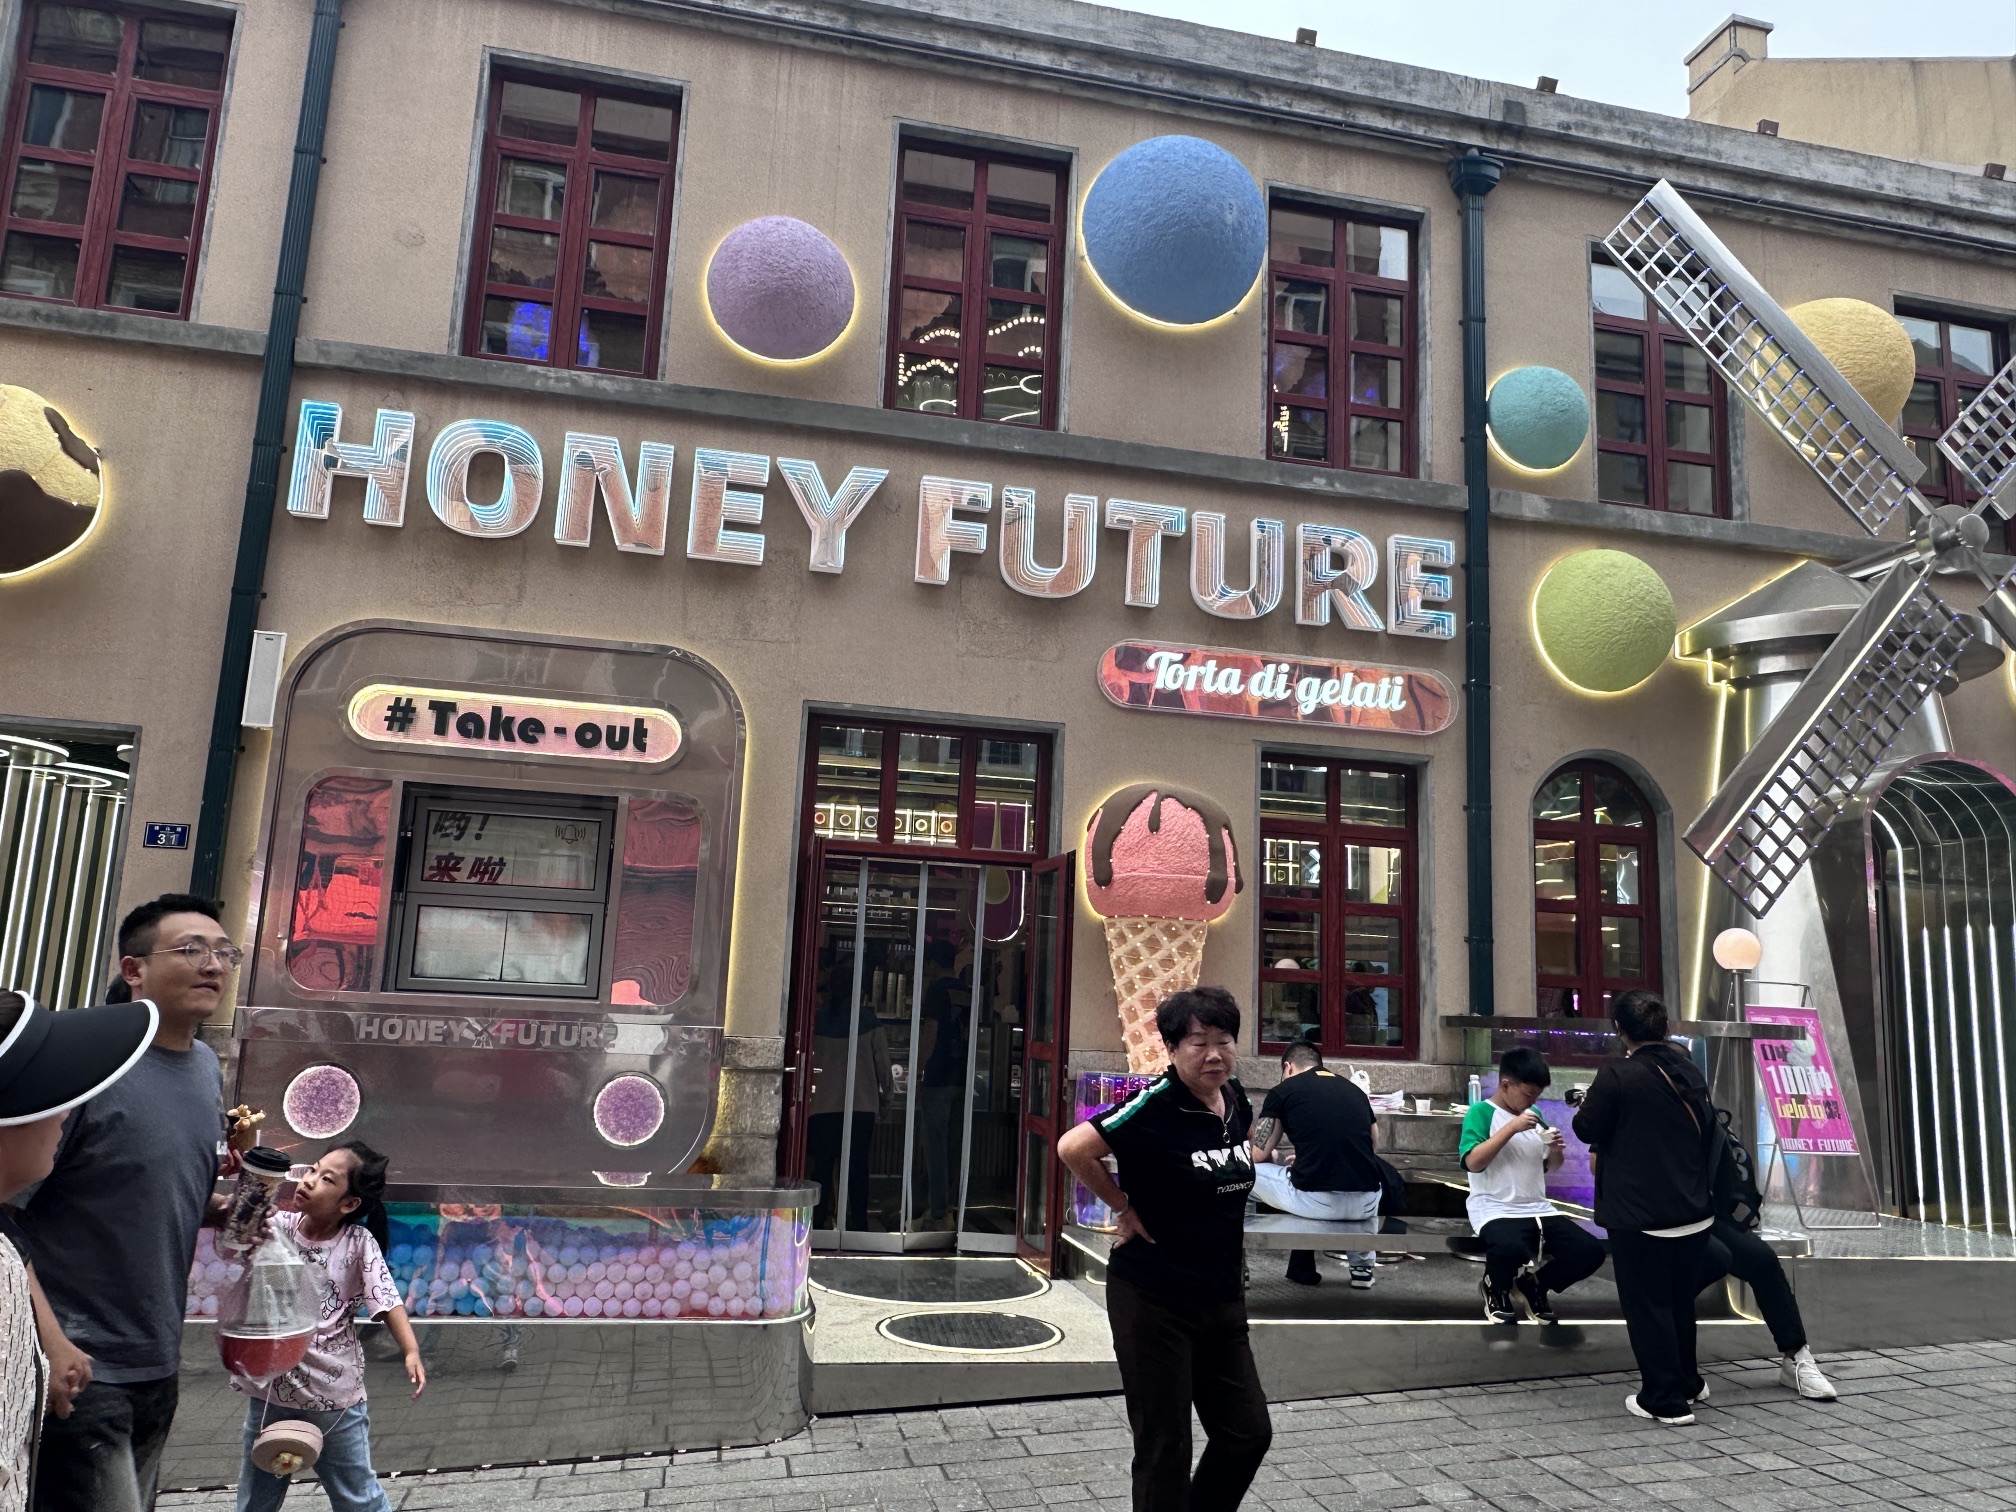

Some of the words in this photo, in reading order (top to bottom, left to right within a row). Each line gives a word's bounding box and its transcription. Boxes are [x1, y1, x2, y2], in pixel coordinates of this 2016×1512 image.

[287, 399, 889, 573] HONEY
[915, 474, 1457, 639] FUTURE
[1147, 651, 1245, 696] Torta
[1248, 662, 1292, 701] di
[1296, 672, 1407, 715] gelati
[157, 833, 177, 846] 31
[424, 852, 507, 884] 来啦
[358, 1017, 469, 1043] HONEY
[500, 1021, 619, 1048] FUTURE
